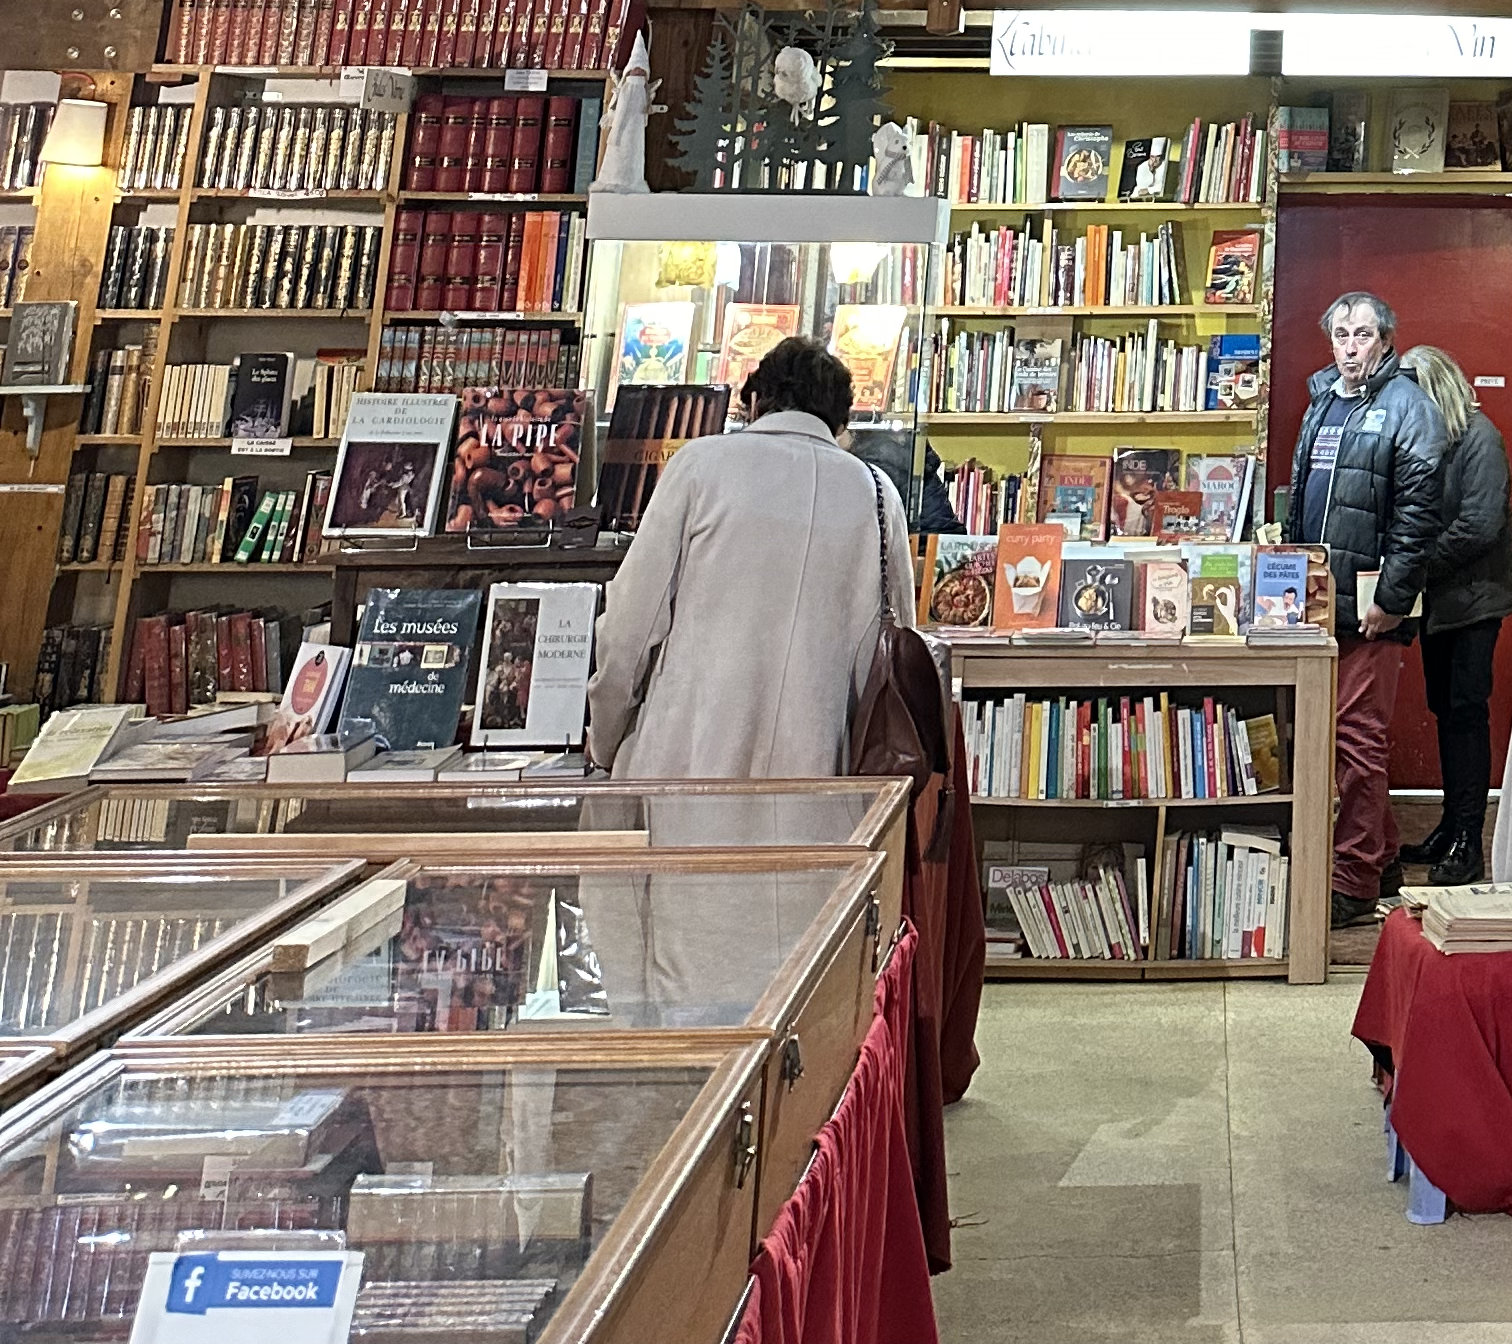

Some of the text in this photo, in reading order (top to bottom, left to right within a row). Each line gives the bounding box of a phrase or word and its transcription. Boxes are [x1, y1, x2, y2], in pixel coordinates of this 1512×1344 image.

[355, 397, 399, 407] HISTOIRE
[351, 416, 446, 425] LA CARDIOLOGIE
[480, 423, 559, 448] LA PIPE
[1122, 459, 1148, 471] INDE
[1005, 534, 1057, 547] curry party
[373, 617, 459, 635] Les musées
[558, 619, 572, 629] LA
[538, 635, 588, 645] CHIRURGIE
[538, 649, 587, 660] MODERNE
[427, 671, 439, 681] de
[389, 679, 446, 694] médecine
[230, 1267, 319, 1280] SUIVEZ-NOUS SUR
[225, 1280, 319, 1301] Facebook
